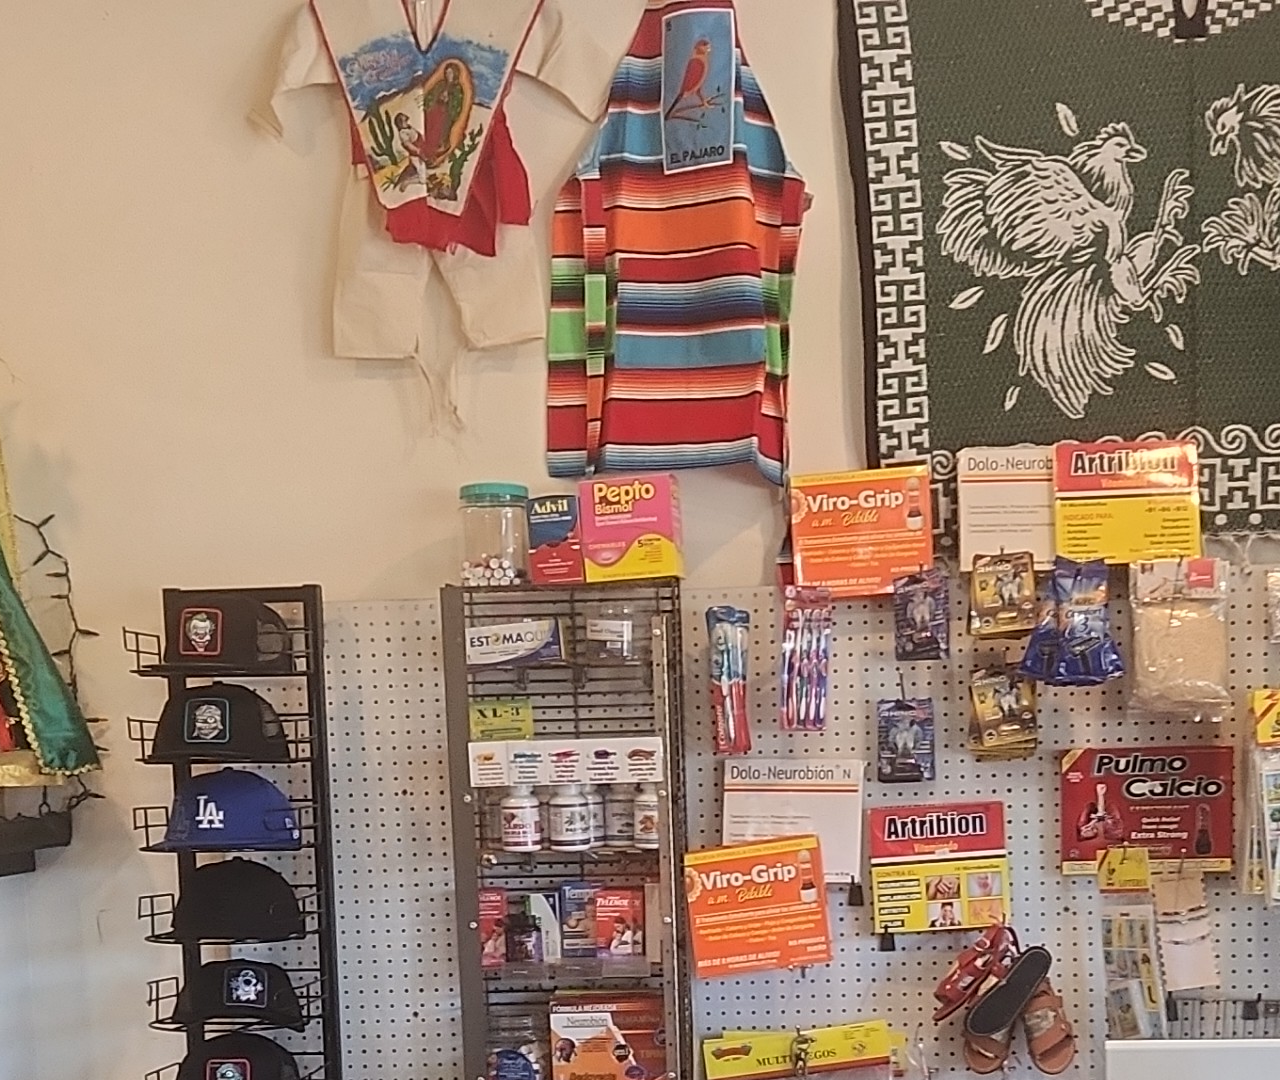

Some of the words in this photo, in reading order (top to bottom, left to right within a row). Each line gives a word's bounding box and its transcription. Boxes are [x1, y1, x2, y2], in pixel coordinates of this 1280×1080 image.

[670, 152, 682, 164] EL
[968, 457, 1053, 472] Dolo-Neurob
[593, 481, 655, 504] Pepto
[807, 489, 904, 512] Viro-Grip
[531, 499, 569, 514] Advil
[594, 502, 633, 515] Bismol
[470, 629, 548, 648] ESTOMAQUI
[730, 765, 834, 780] Dolo-Neurobión
[843, 769, 851, 779] N
[1094, 753, 1188, 776] Pulmo
[1124, 775, 1223, 799] Calcio
[195, 795, 224, 829] LA
[884, 812, 987, 841] Artribion
[1131, 831, 1155, 839] Extra
[700, 863, 797, 890] Viro-Grip
[756, 1049, 837, 1067] MULTIEGOS
